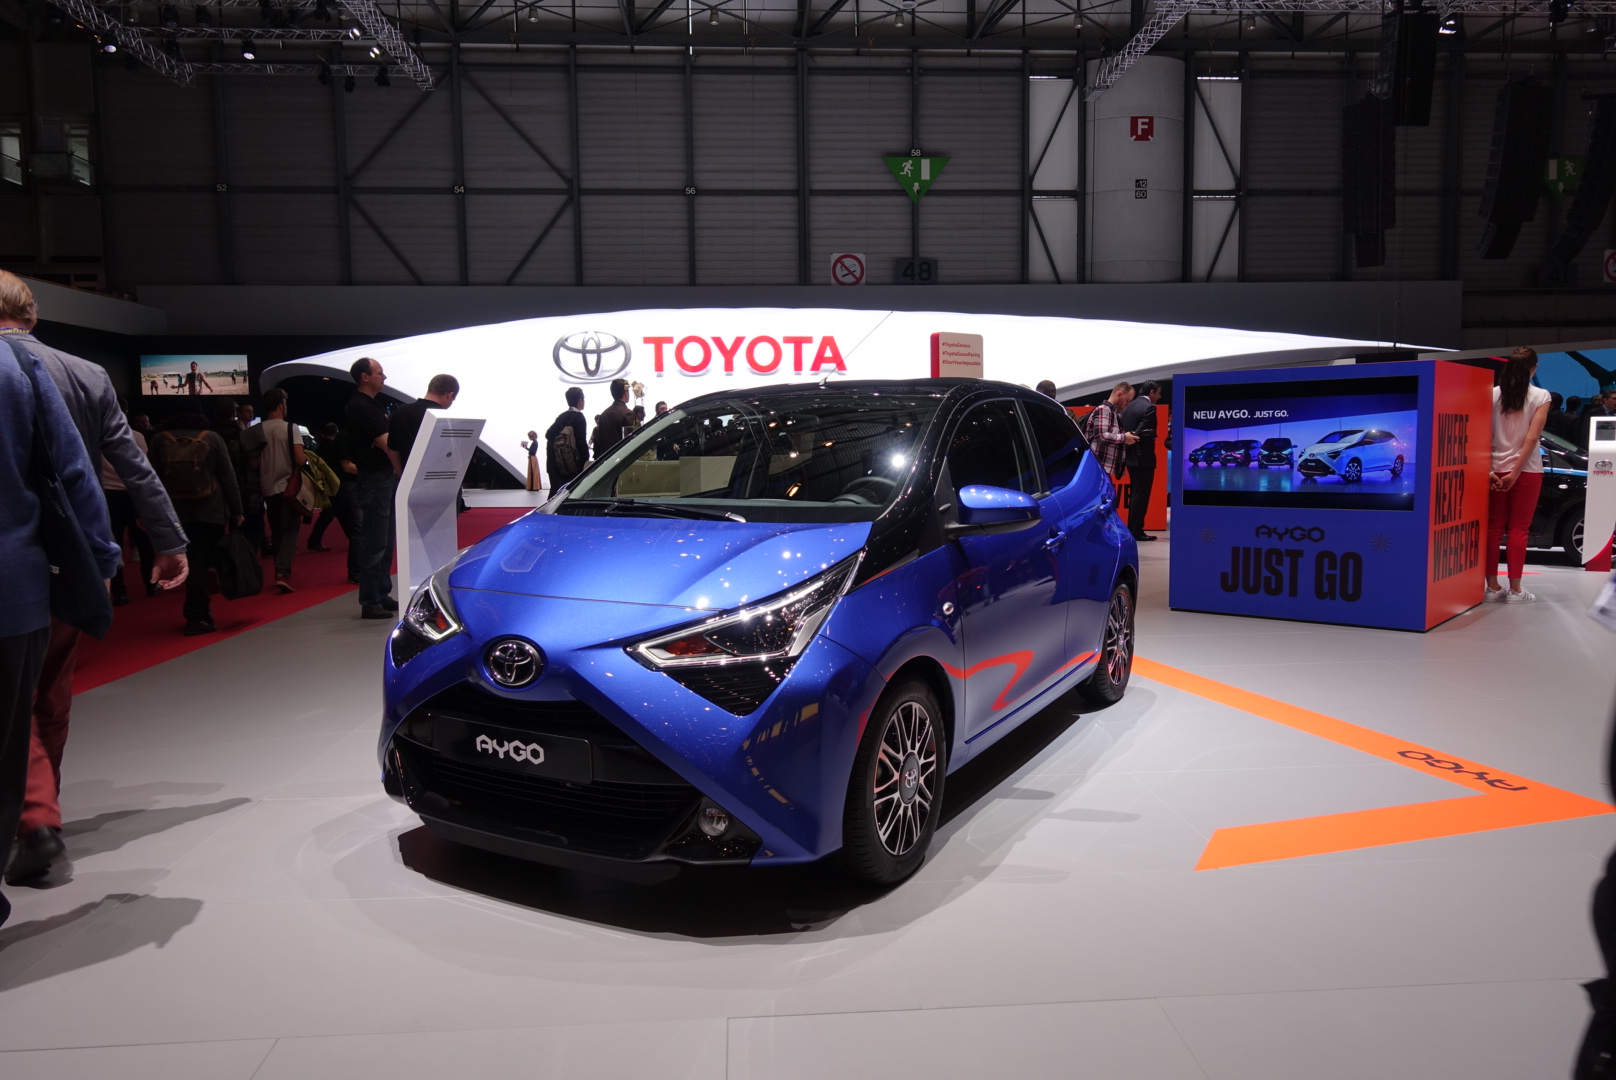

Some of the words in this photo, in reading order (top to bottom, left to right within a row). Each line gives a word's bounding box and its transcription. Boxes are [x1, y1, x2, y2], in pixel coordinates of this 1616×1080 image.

[1138, 118, 1149, 135] F
[910, 149, 921, 157] 58
[216, 184, 227, 192] 52
[454, 186, 465, 194] 54
[685, 187, 696, 195] 56
[1136, 190, 1147, 198] 60
[902, 261, 932, 281] 48
[643, 335, 847, 373] TOYOTA
[1193, 411, 1216, 419] NEW
[1218, 410, 1251, 418] AYGO.
[1253, 410, 1274, 418] JUST
[1438, 413, 1469, 467] WHERE
[1434, 469, 1465, 526] NEXT?
[1255, 524, 1325, 543] AYGO
[1433, 519, 1480, 583] WHEREVER
[1220, 546, 1304, 597] JUST
[1314, 550, 1363, 603] GO
[476, 734, 545, 765] AYGO
[1397, 751, 1529, 791] AYGO
